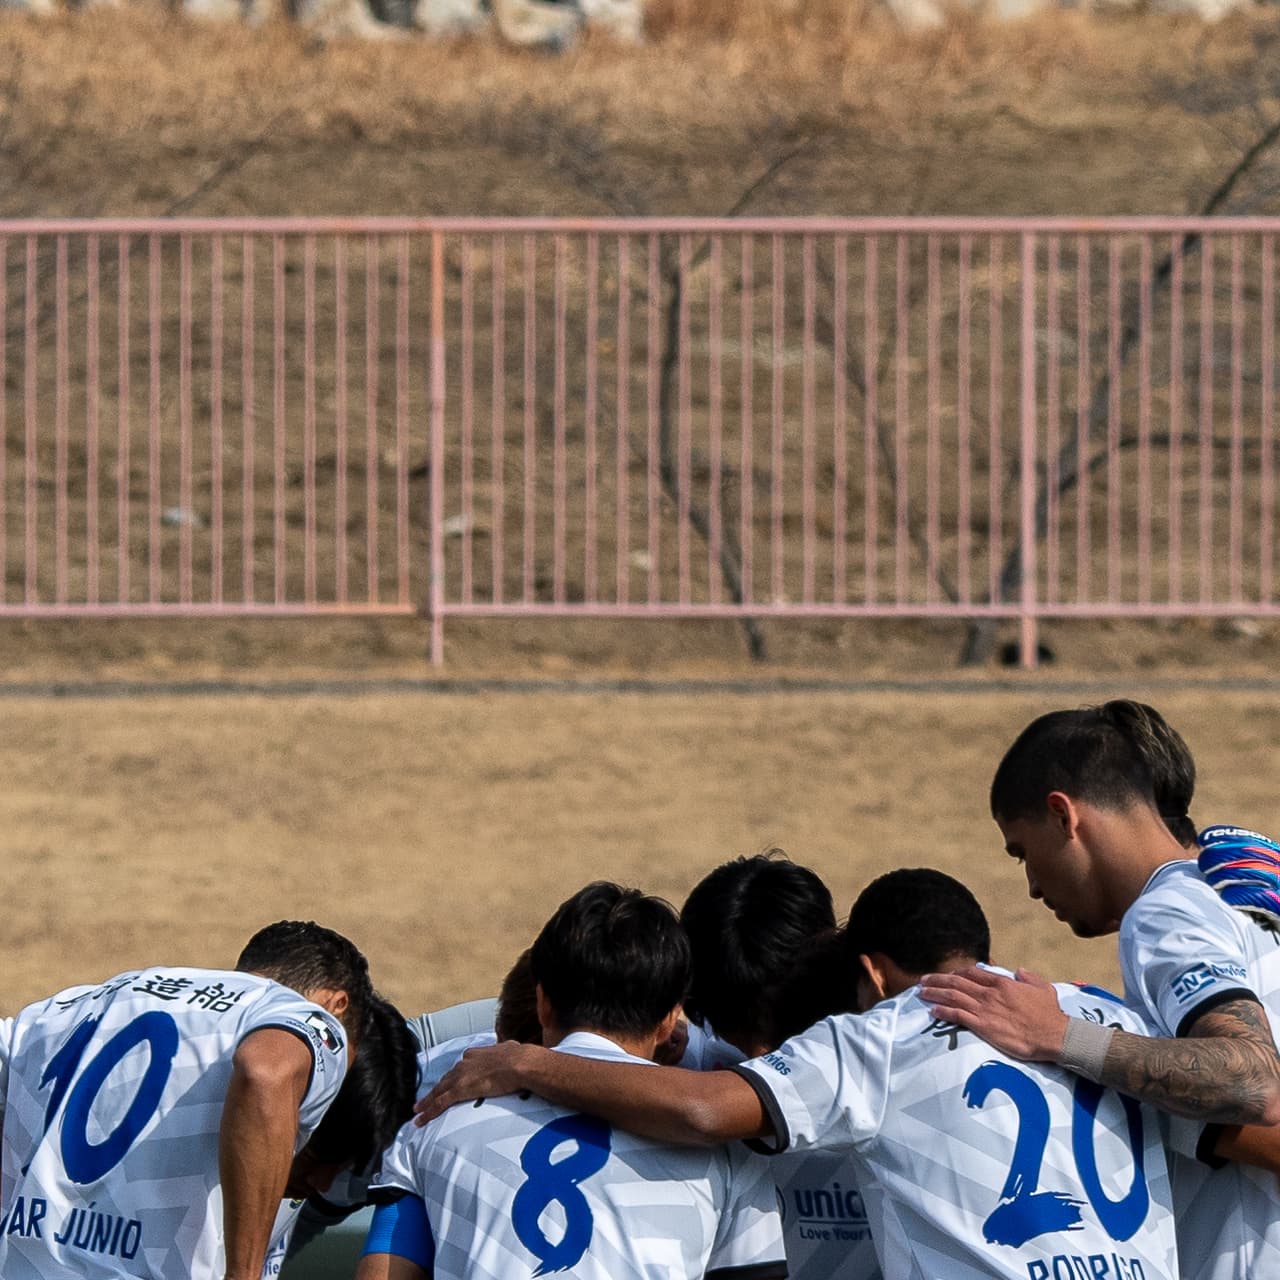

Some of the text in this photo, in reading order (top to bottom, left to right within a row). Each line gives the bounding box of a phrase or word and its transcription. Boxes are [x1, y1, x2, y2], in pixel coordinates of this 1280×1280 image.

[22, 1010, 180, 1186] 10
[962, 1059, 1150, 1249] 20
[53, 1201, 143, 1260] JÚNIO
[511, 1113, 612, 1279] 8
